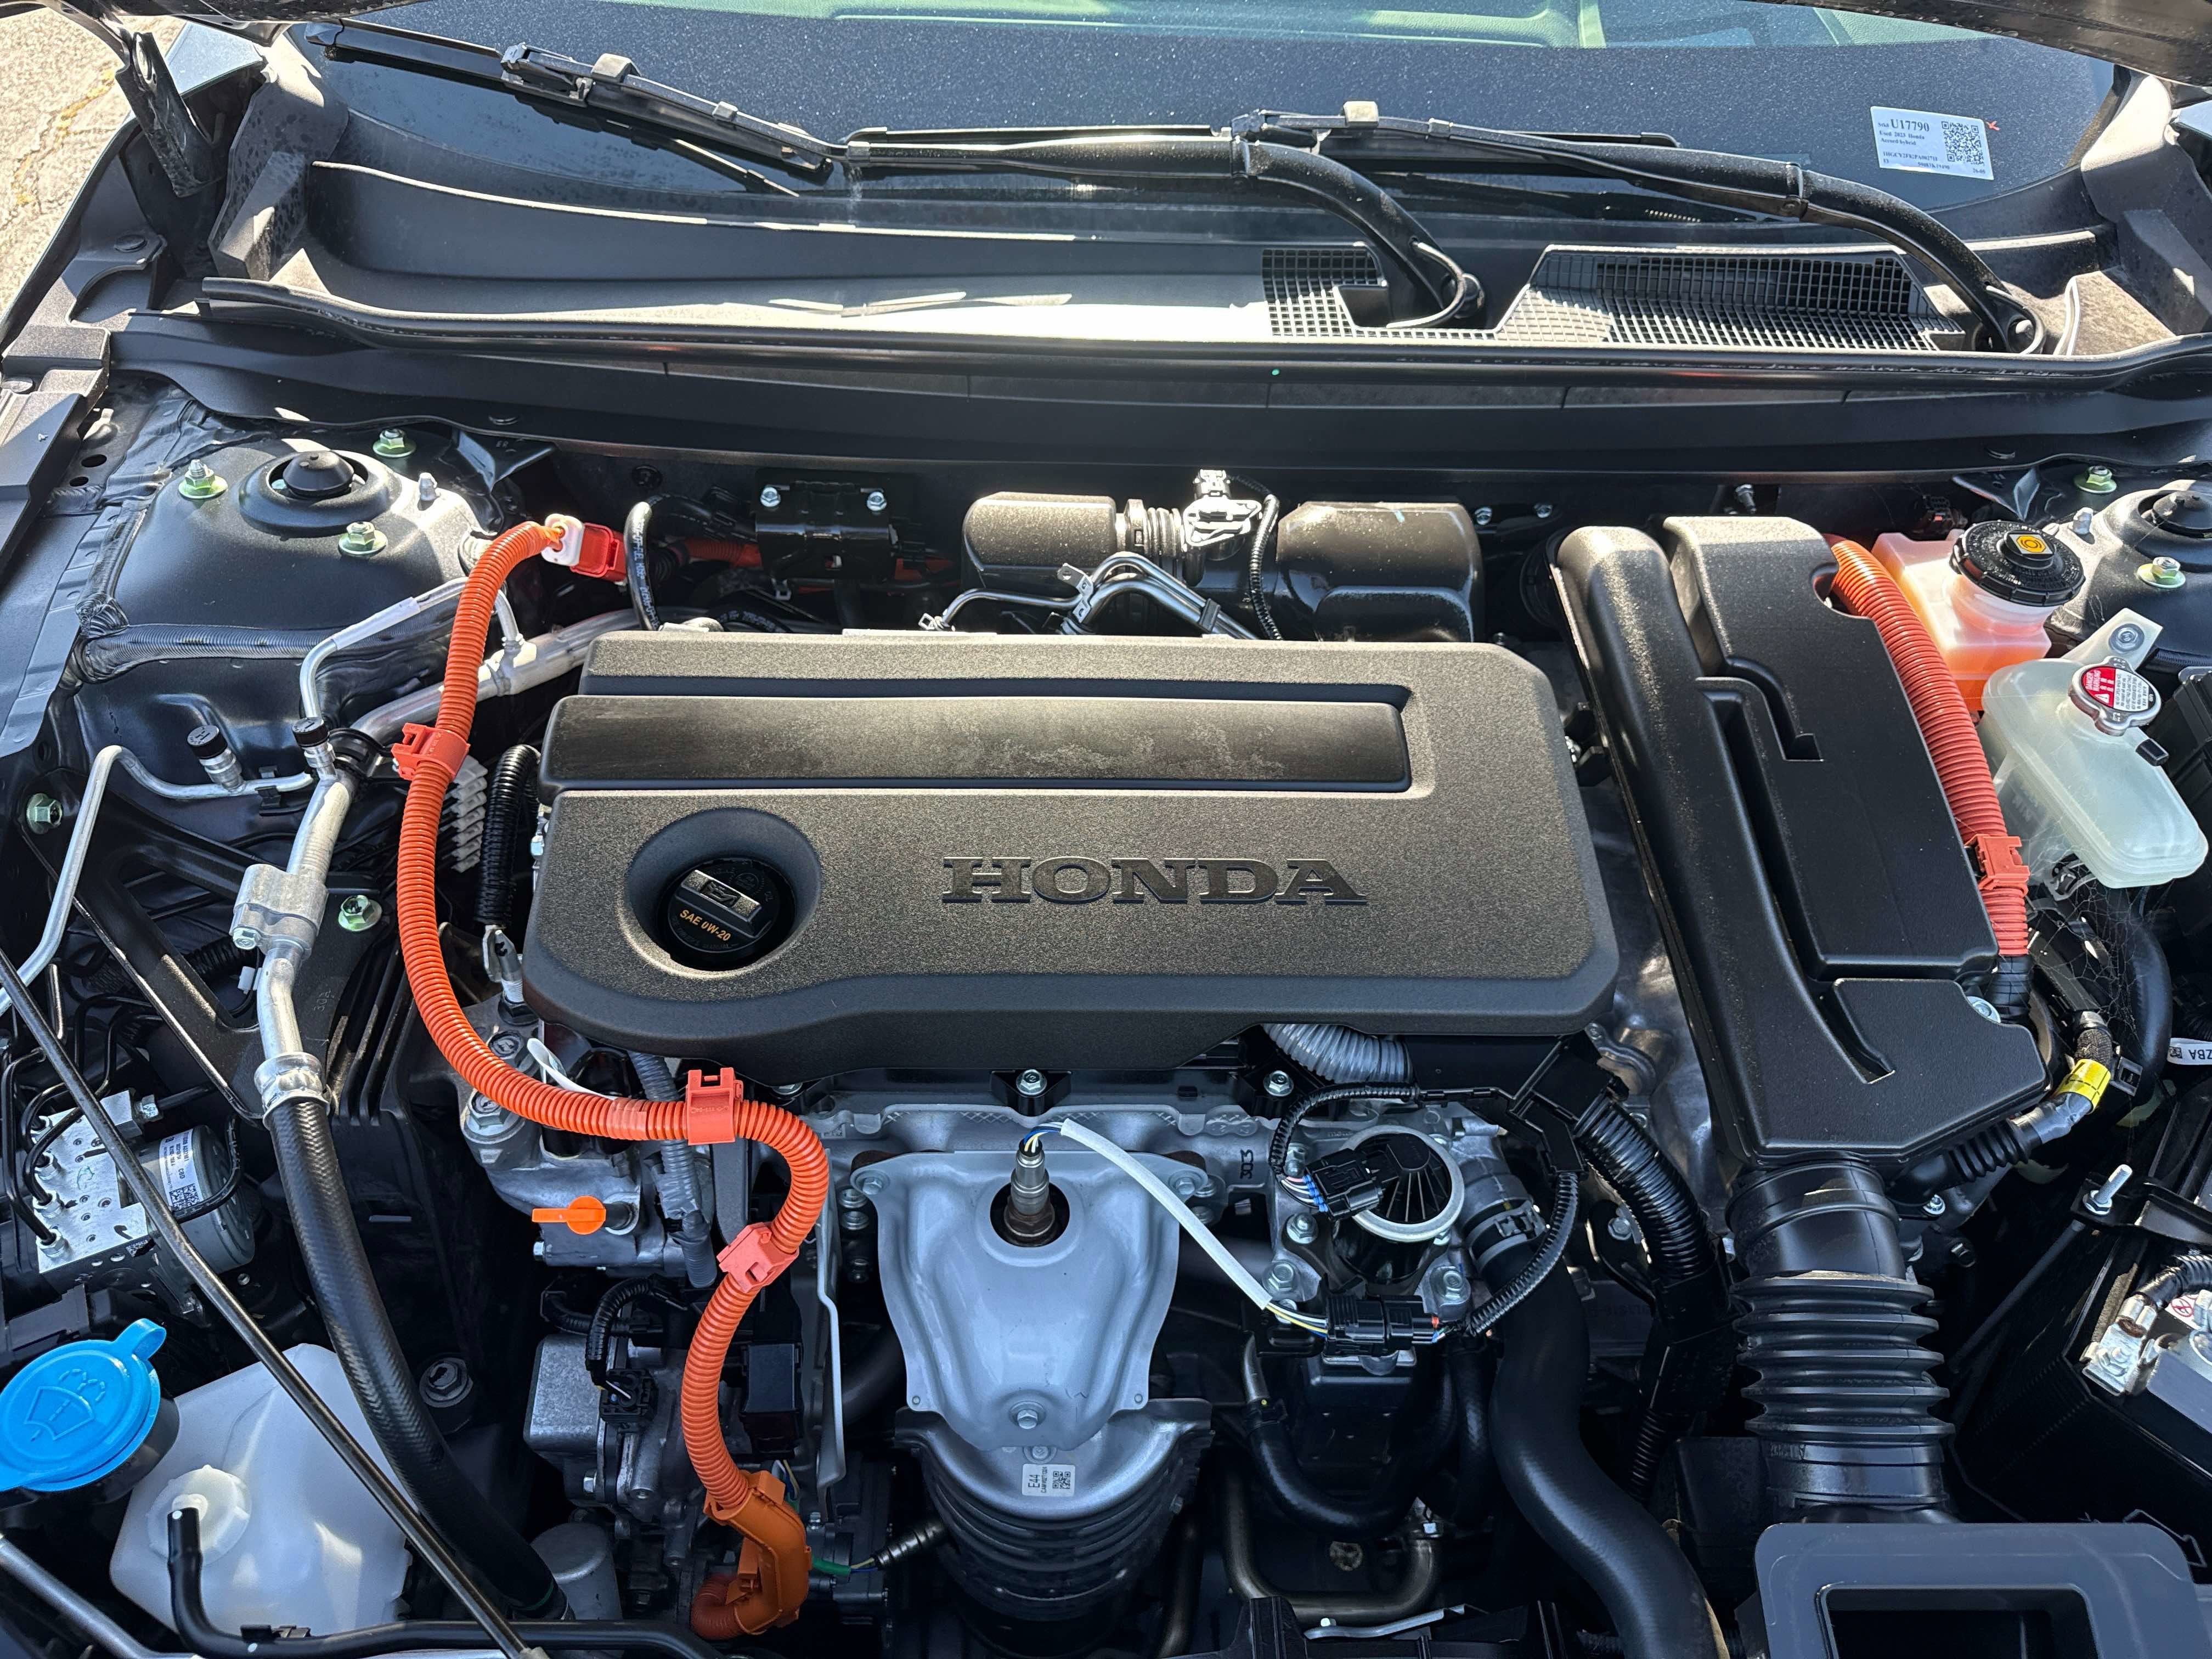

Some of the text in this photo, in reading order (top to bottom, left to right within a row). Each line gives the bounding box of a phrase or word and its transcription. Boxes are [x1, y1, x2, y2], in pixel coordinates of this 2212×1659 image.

[1891, 119, 1929, 132] U17790
[942, 856, 1368, 904] HONDA
[680, 910, 731, 941] SAE 0W-20
[1028, 1474, 1040, 1488] E44
